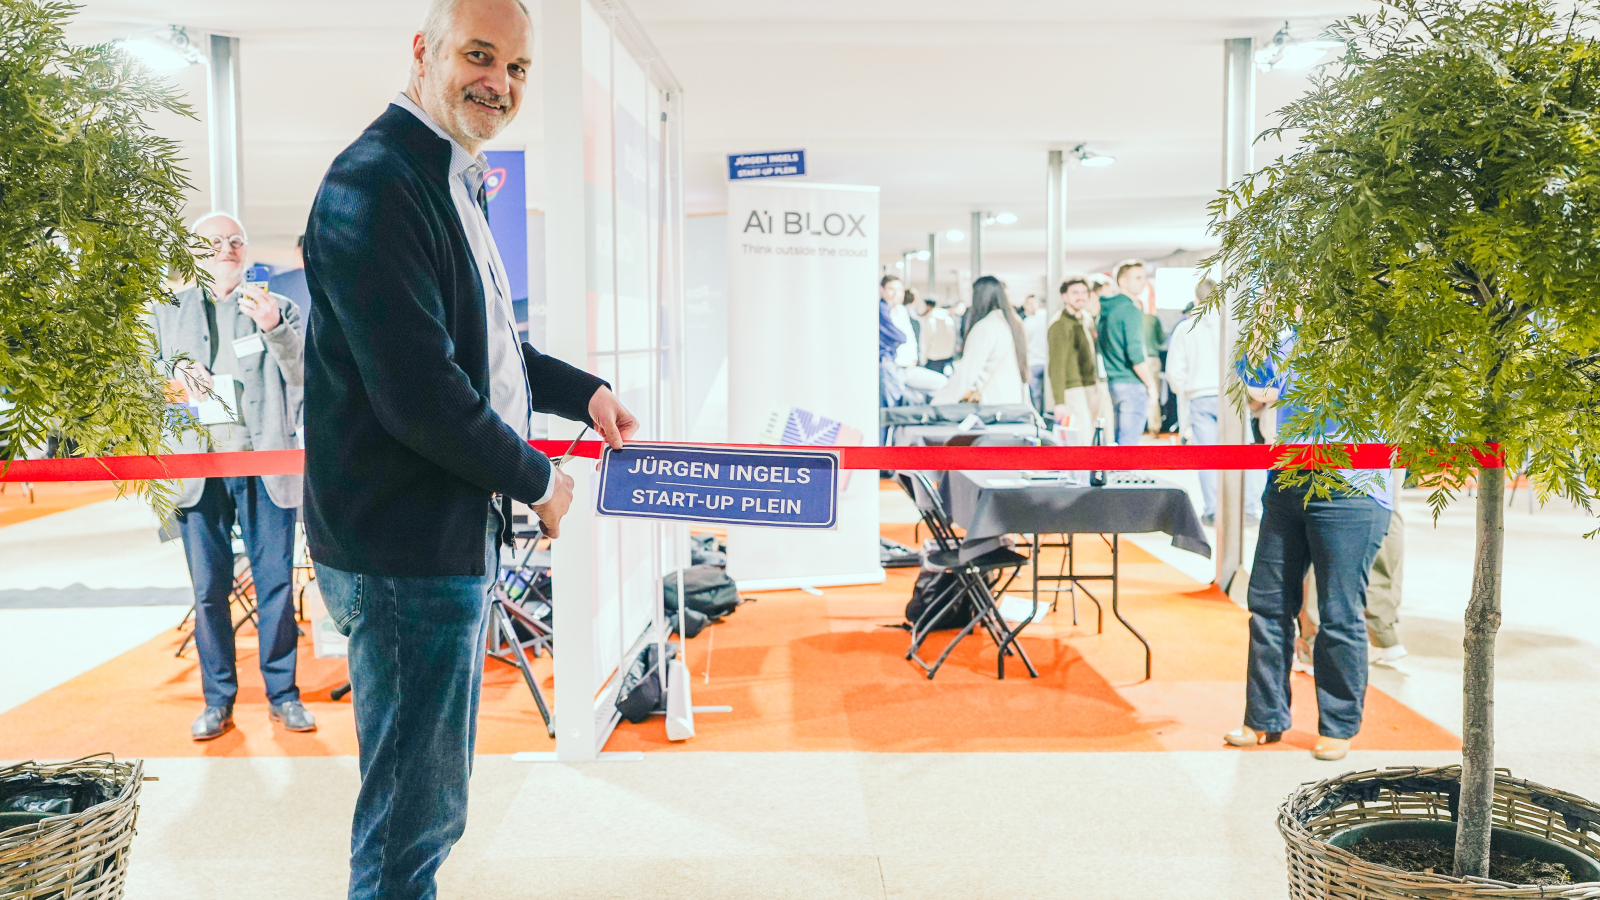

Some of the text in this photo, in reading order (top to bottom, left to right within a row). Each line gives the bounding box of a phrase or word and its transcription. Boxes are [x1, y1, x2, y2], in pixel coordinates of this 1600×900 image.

[769, 153, 799, 163] INGELS
[775, 166, 797, 175] PLEIN
[784, 212, 866, 237] BLOX
[742, 244, 868, 258] Think outside the cloud
[628, 455, 811, 484] JÜRGEN INGELS
[631, 489, 801, 515] START-UP PLEIN
